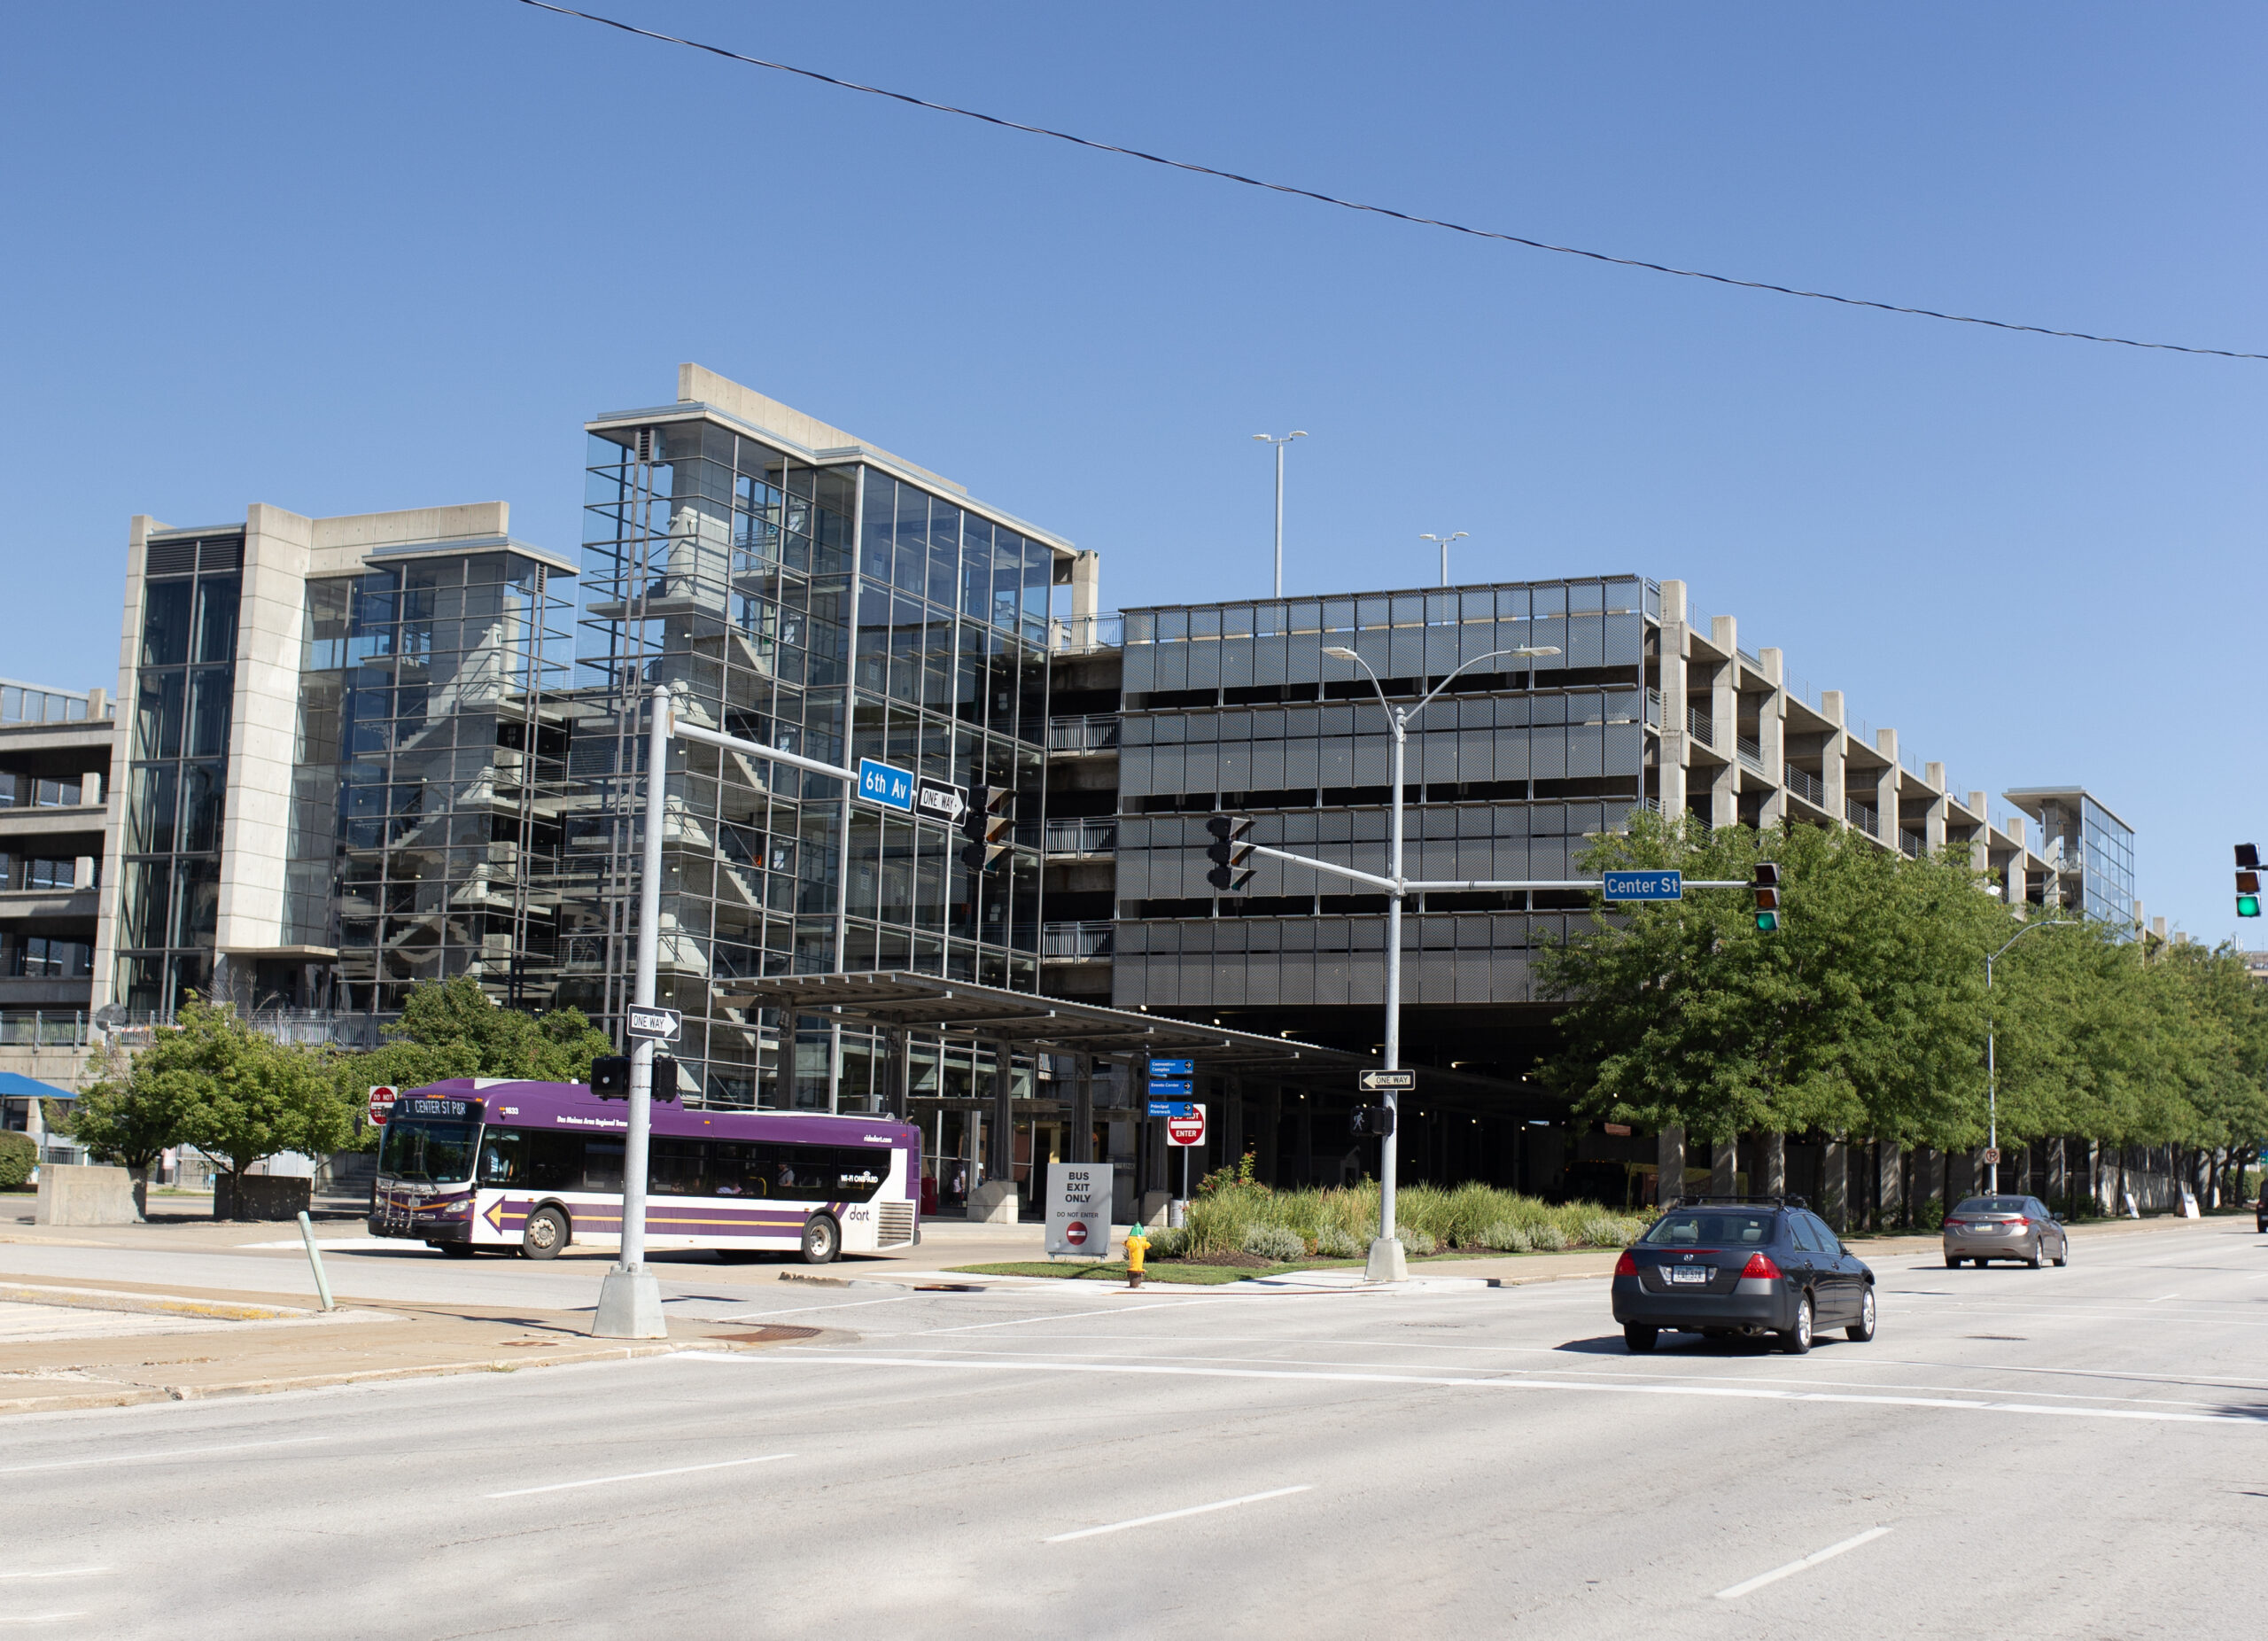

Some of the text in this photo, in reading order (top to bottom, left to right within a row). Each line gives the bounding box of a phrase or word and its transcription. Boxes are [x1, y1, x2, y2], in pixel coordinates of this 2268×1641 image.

[866, 771, 906, 799] 6th Av
[923, 790, 955, 811] ONE WAY
[1607, 877, 1679, 893] Center St
[633, 1015, 664, 1030] ONE WAY
[405, 1100, 466, 1116] 1 CENTER ST P&R
[595, 1118, 616, 1127] Regional
[1068, 1171, 1090, 1180] BUS
[1067, 1183, 1091, 1192] EXIT
[1065, 1194, 1091, 1202] ONLY
[850, 1205, 870, 1221] dart
